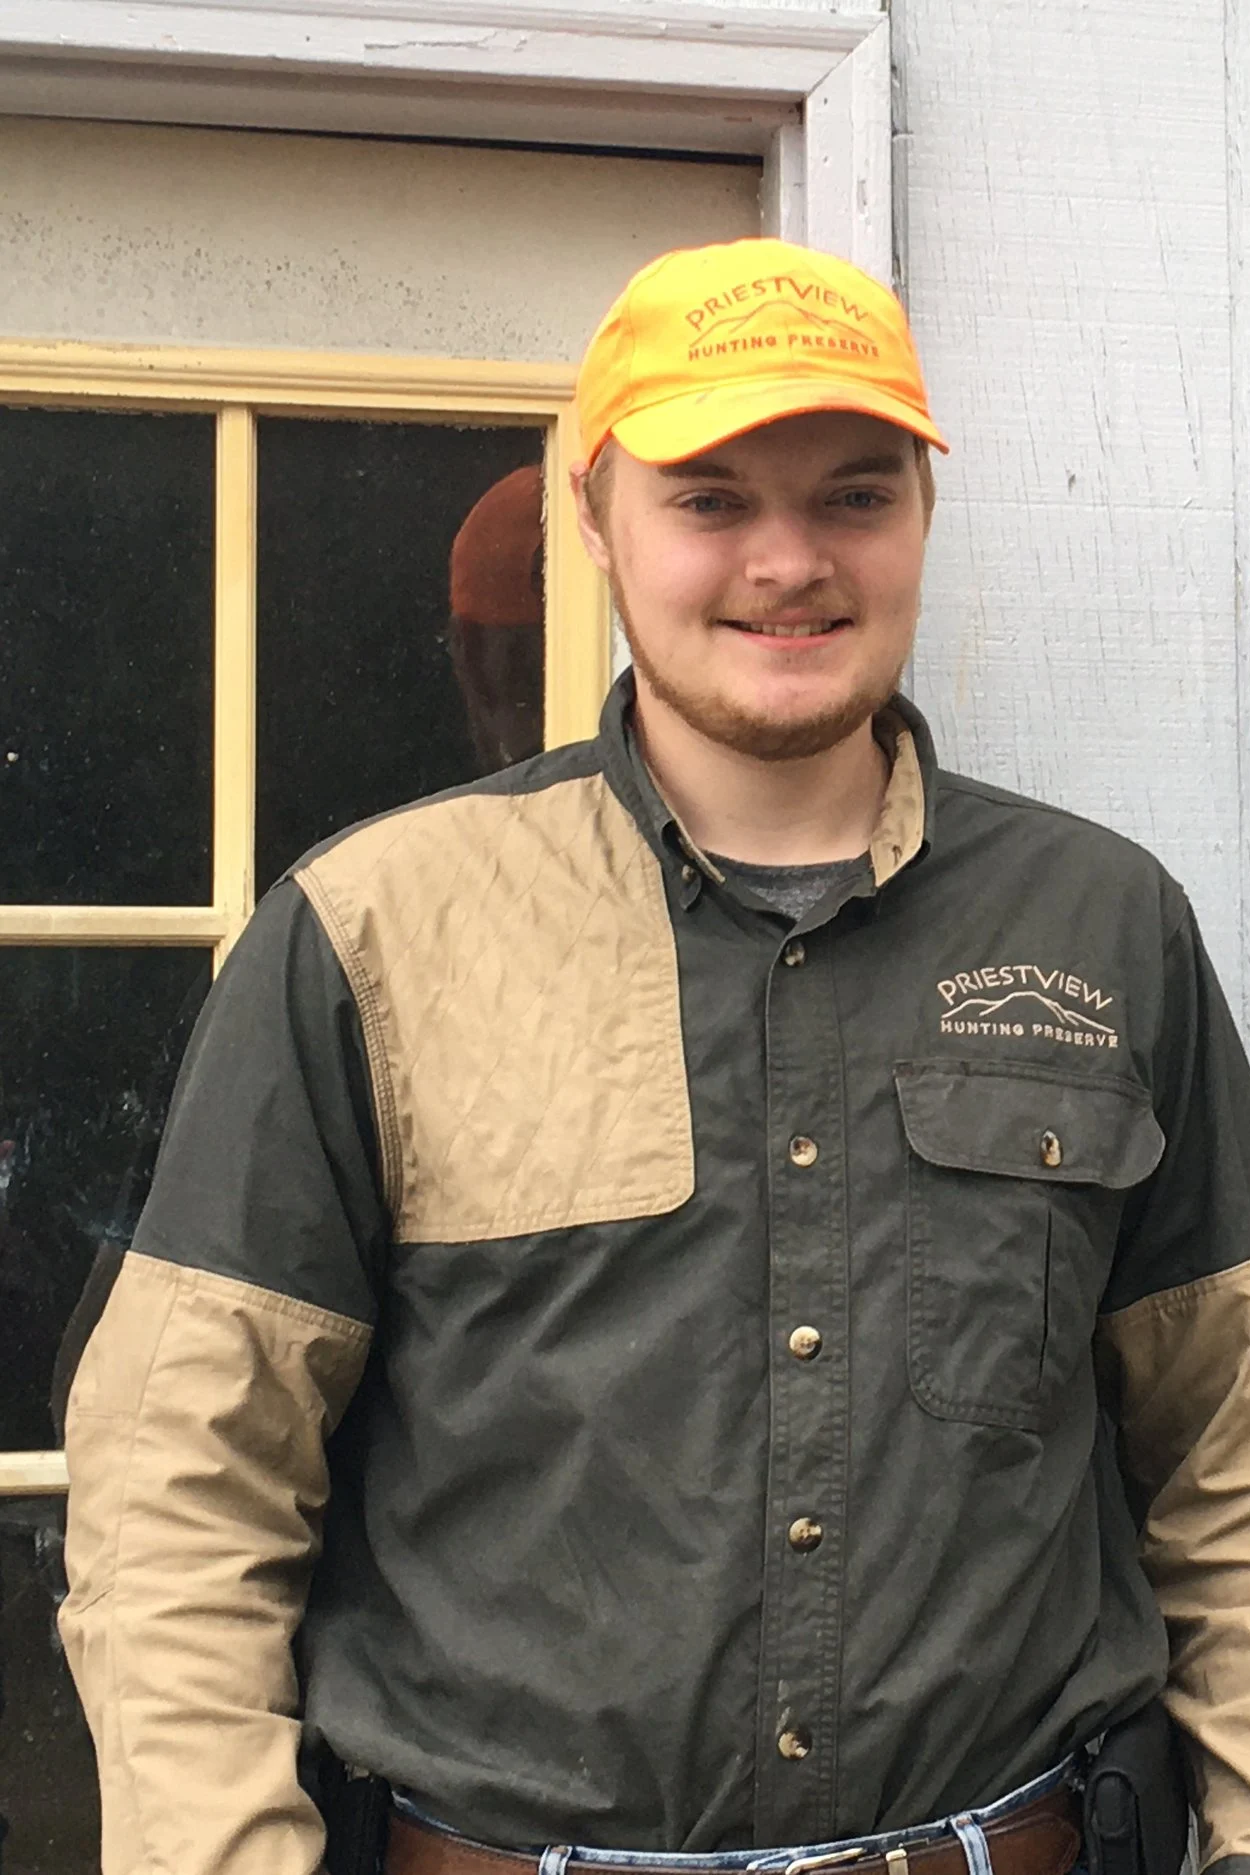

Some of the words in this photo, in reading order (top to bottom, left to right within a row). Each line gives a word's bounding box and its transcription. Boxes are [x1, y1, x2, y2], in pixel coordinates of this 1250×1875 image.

[684, 276, 869, 332] PRIESTVIEW
[688, 335, 778, 361] HUNTING
[788, 334, 880, 358] PRESERVE
[937, 965, 1113, 1011] PRIESTVIEW
[940, 1020, 1025, 1036] HUNTING
[1032, 1023, 1119, 1048] PRESERVE
